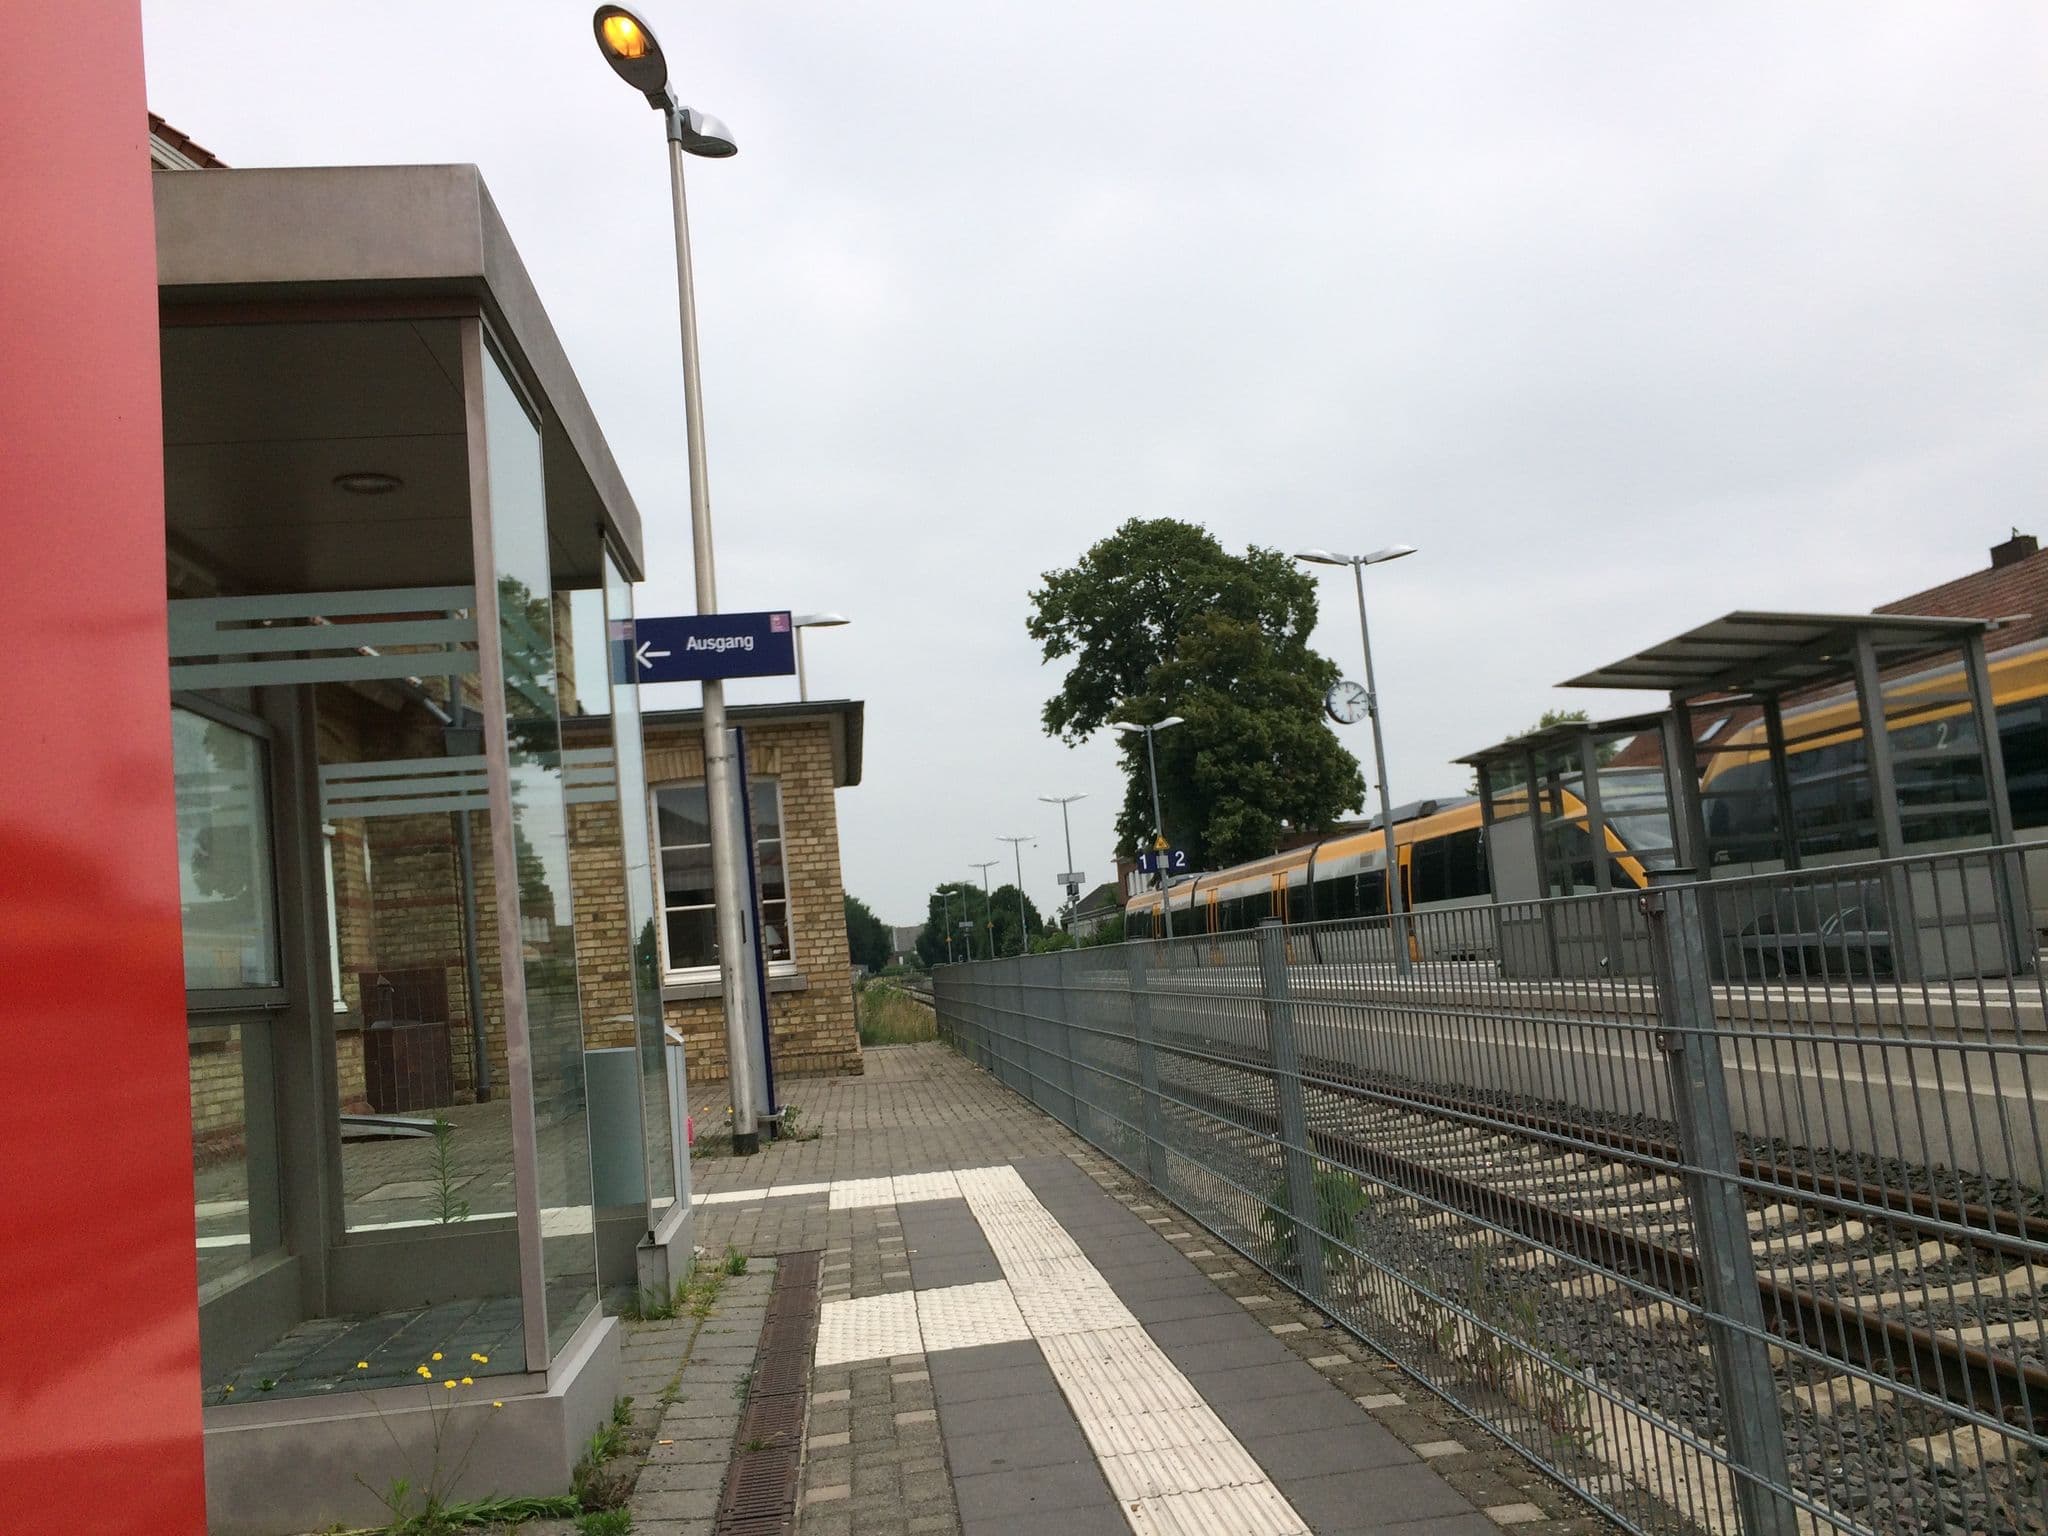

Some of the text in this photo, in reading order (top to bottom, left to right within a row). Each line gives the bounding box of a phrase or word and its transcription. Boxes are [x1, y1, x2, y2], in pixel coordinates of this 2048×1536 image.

[686, 635, 754, 653] Ausgang
[1937, 722, 1948, 750] 2
[1139, 853, 1148, 870] 1
[1175, 850, 1186, 867] 2
